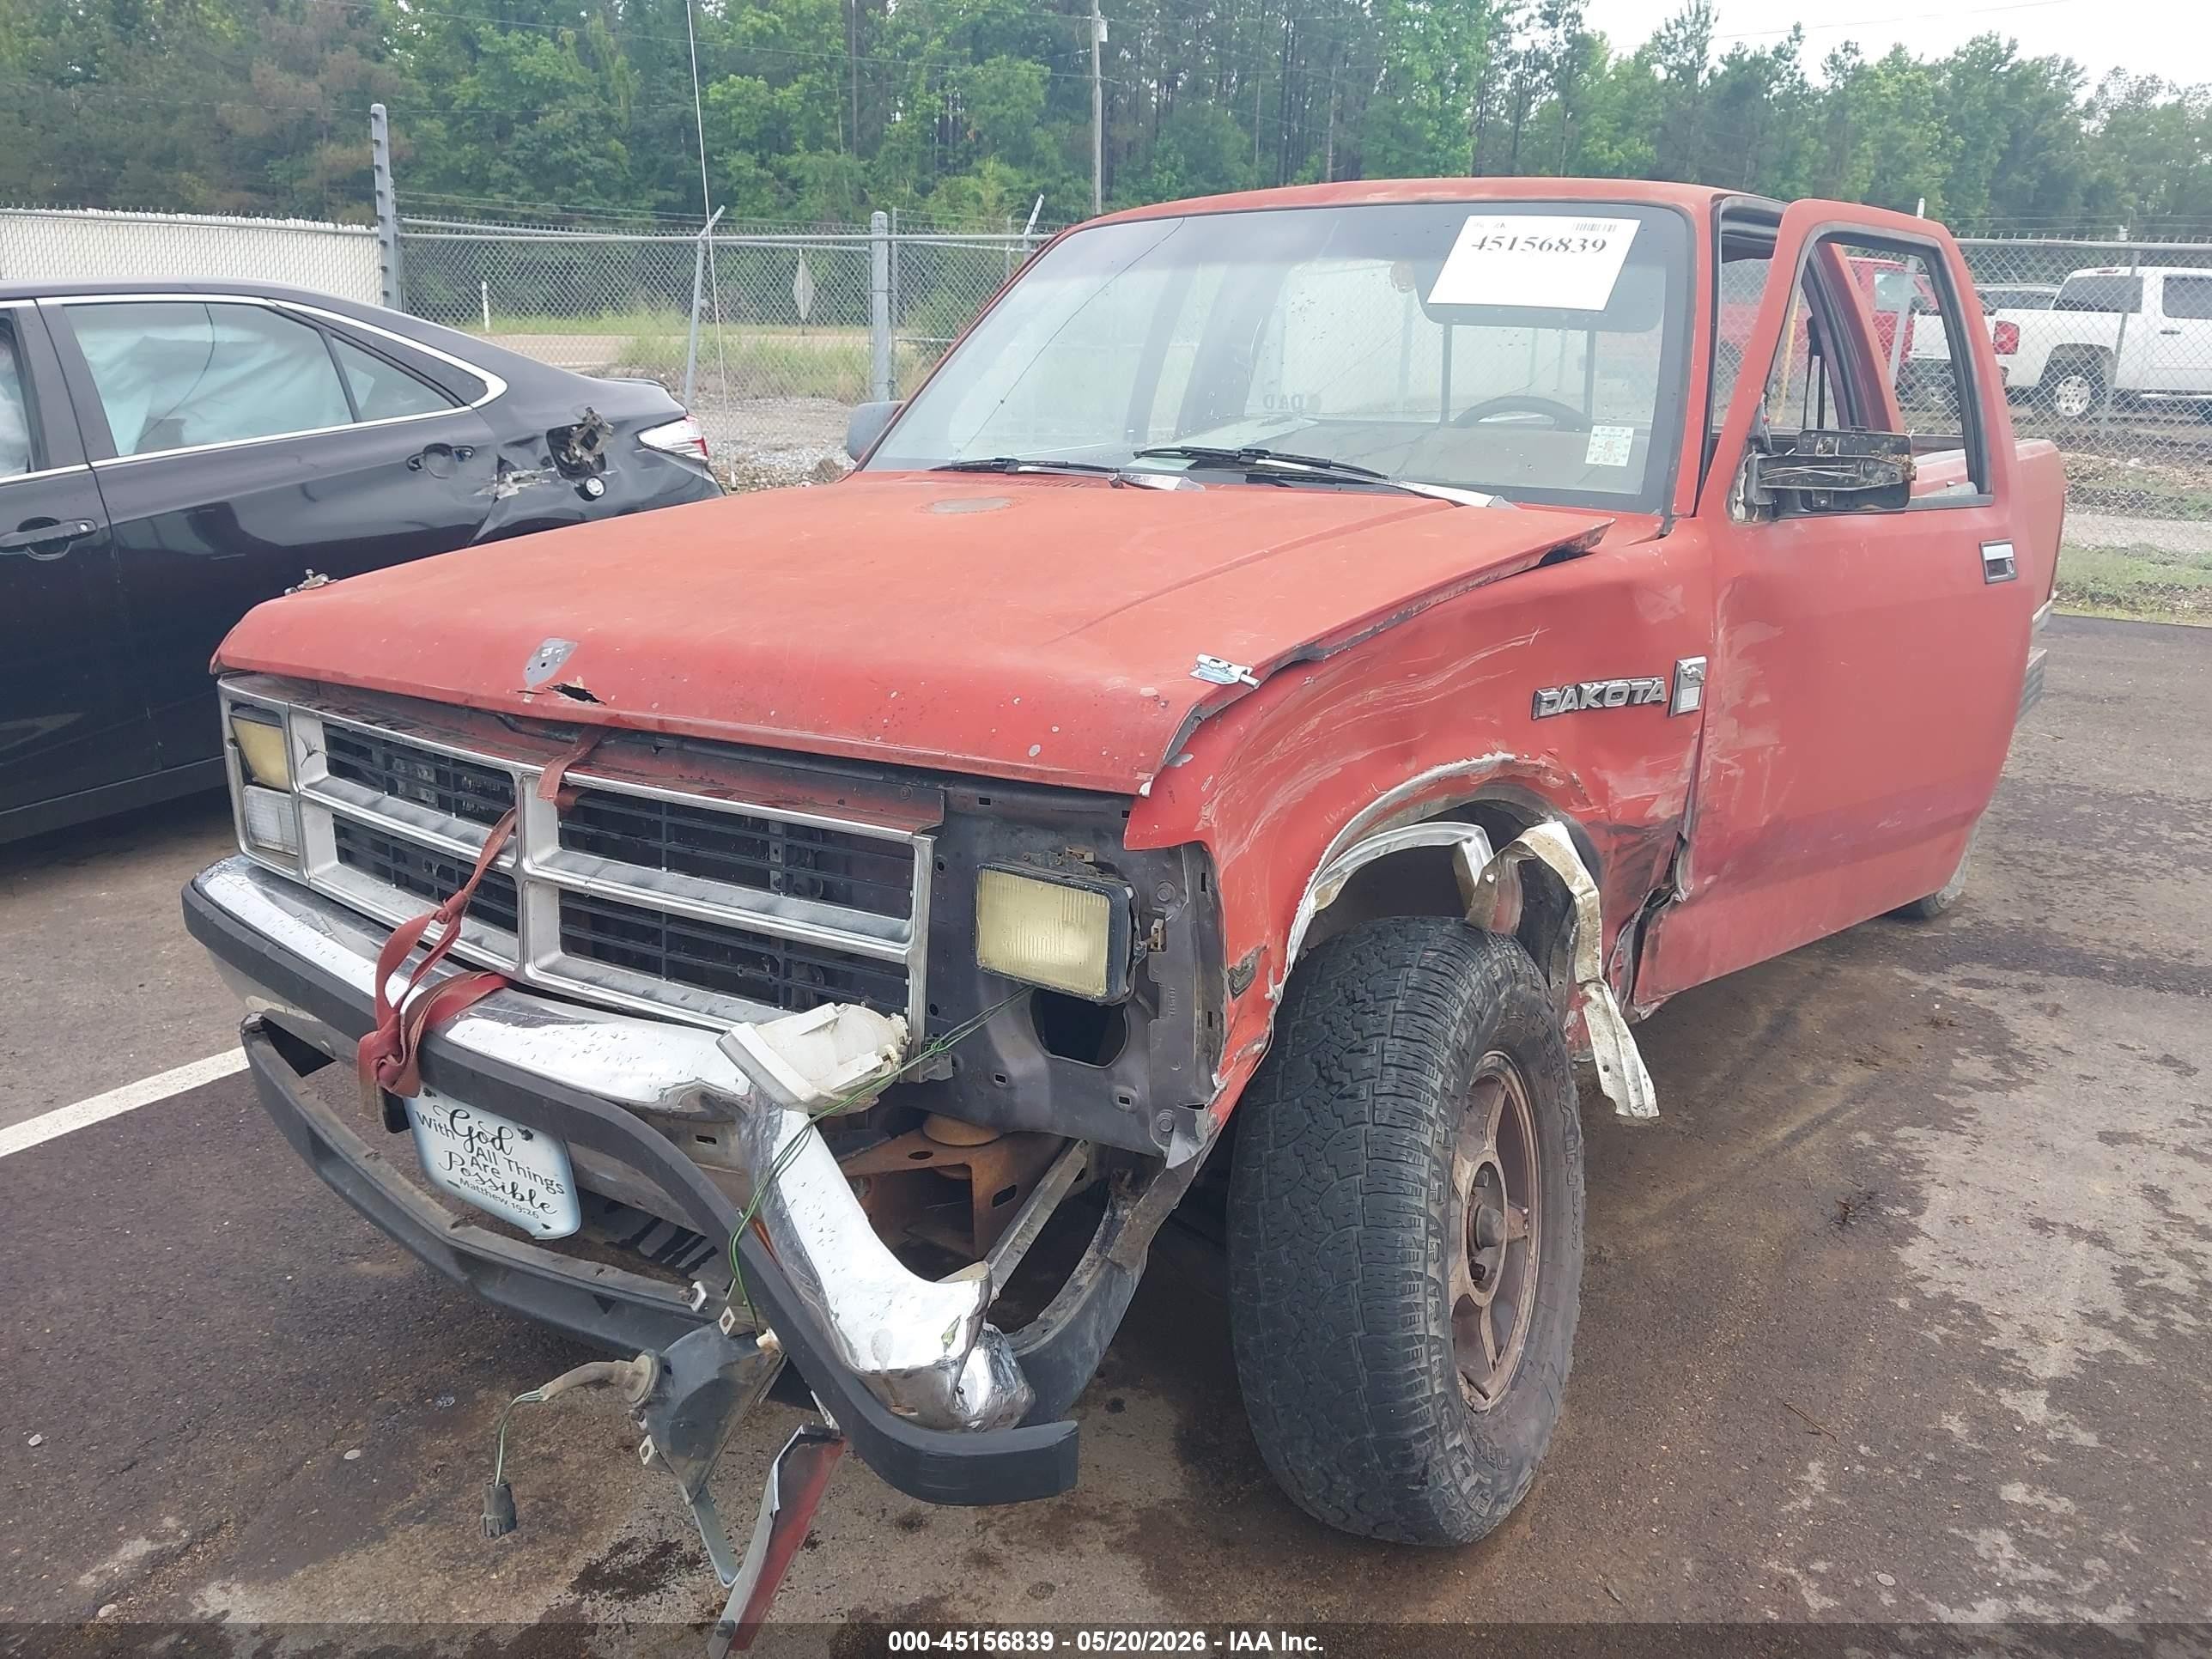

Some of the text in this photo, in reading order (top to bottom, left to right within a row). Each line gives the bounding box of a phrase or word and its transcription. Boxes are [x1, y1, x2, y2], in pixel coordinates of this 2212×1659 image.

[1471, 234, 1607, 254] 45156839
[1532, 677, 1668, 720] DAKOTA
[416, 1104, 514, 1155] With God
[438, 1150, 557, 1215] Possible
[471, 1156, 501, 1179] Are
[475, 1146, 565, 1194] All Things
